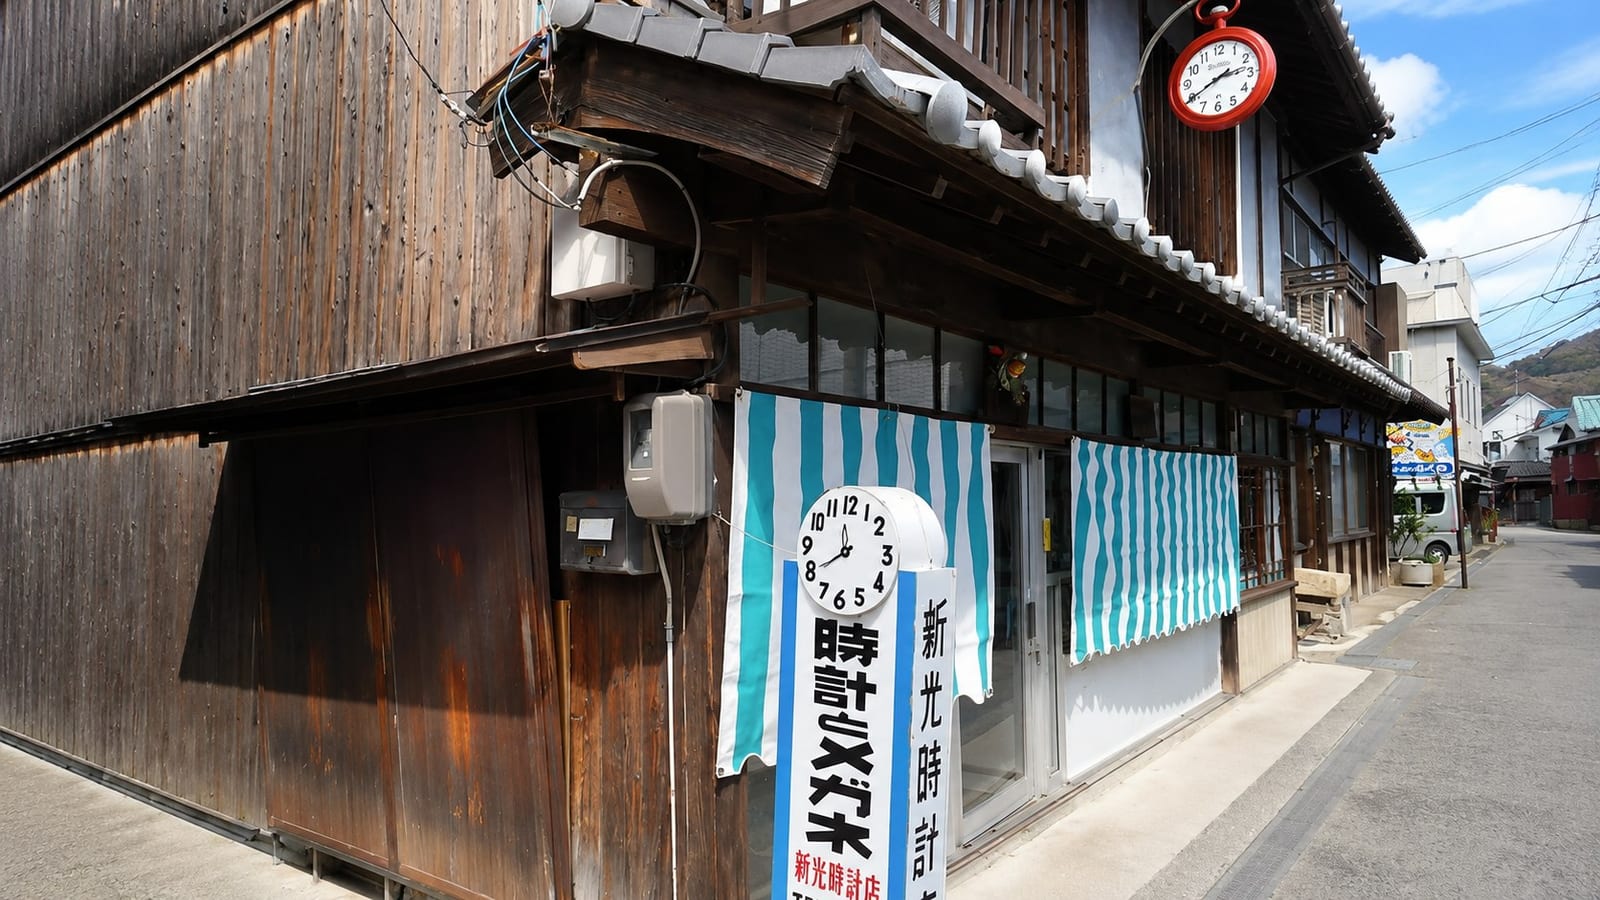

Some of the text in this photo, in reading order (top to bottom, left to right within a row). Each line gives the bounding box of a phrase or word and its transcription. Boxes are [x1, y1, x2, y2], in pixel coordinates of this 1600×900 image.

[1200, 51, 1208, 64] 11
[1214, 44, 1224, 56] 12
[1233, 43, 1237, 55] 1
[1242, 53, 1249, 64] 2
[1189, 64, 1199, 76] 10
[1247, 67, 1254, 77] 3
[1183, 79, 1191, 90] 9
[1240, 82, 1248, 92] 4
[1200, 101, 1207, 112] 7
[1214, 101, 1221, 111] 6
[1230, 96, 1237, 106] 5
[827, 499, 838, 517] 11
[843, 495, 858, 515] 12
[864, 504, 869, 521] 1
[811, 513, 824, 531] 10
[874, 516, 885, 536] 2
[802, 536, 813, 555] 9
[882, 545, 893, 566] 3
[805, 560, 815, 581] 8
[819, 582, 829, 599] 7
[873, 571, 884, 593] 4
[834, 590, 845, 609] 6
[854, 588, 865, 606] 5
[806, 617, 879, 860] 時計とメガネ
[912, 599, 948, 900] 新光時計
[795, 849, 881, 900] 新光時計店
